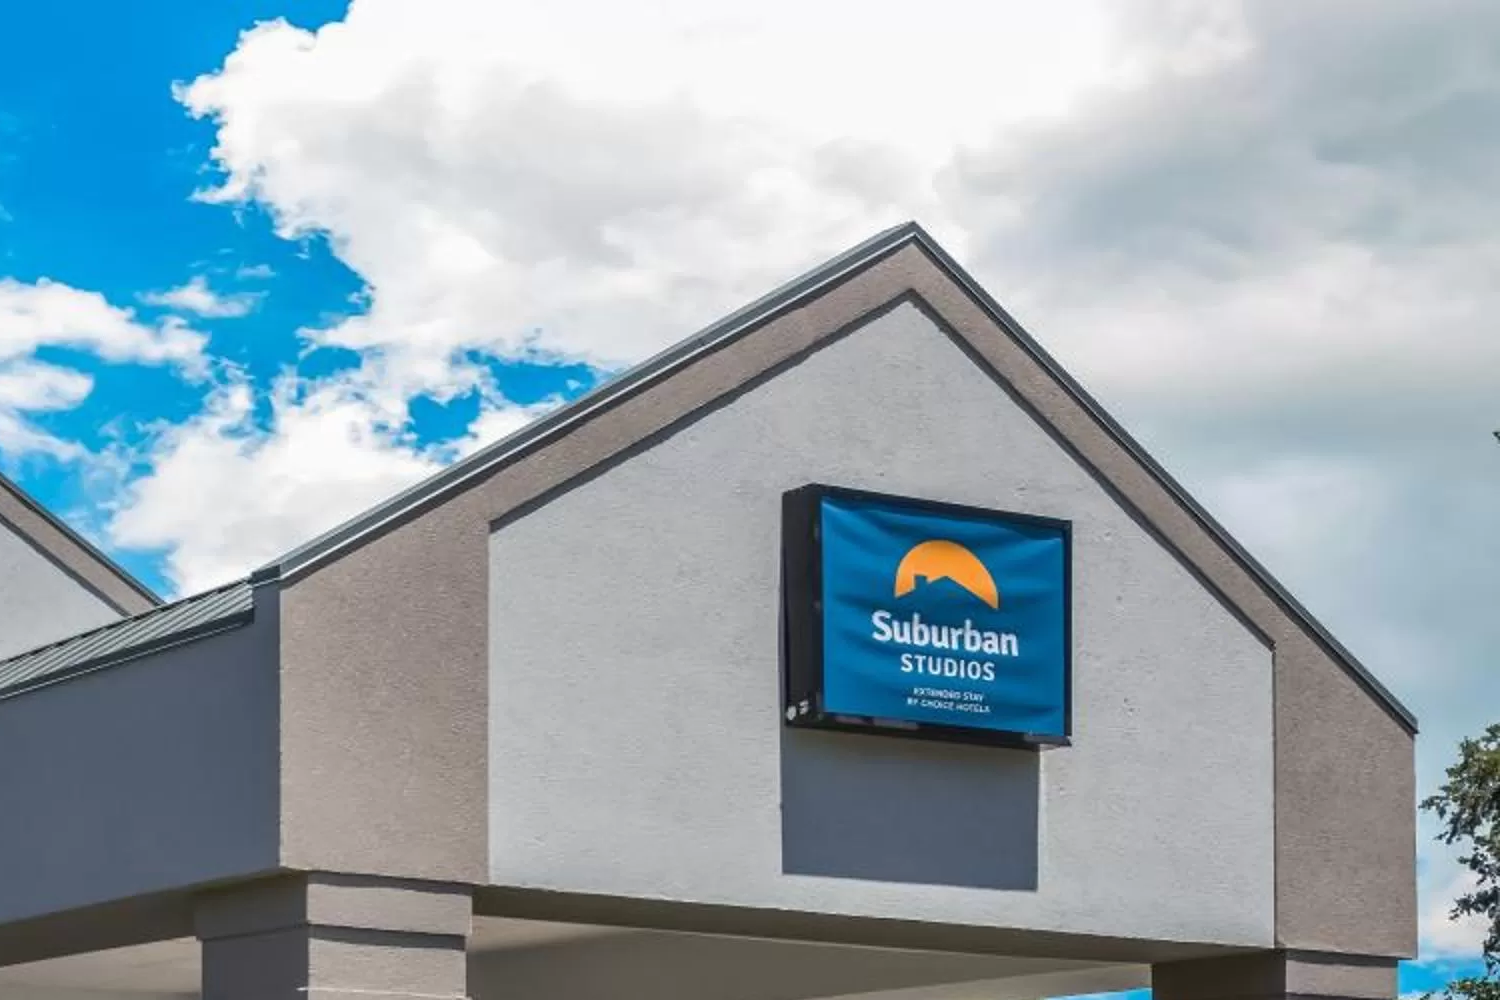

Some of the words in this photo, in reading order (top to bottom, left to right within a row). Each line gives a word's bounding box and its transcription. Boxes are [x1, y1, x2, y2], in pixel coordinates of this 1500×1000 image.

[871, 609, 1020, 657] Suburban
[900, 653, 996, 681] STUDIOS
[921, 699, 955, 711] CHOICE
[963, 691, 985, 703] STAY
